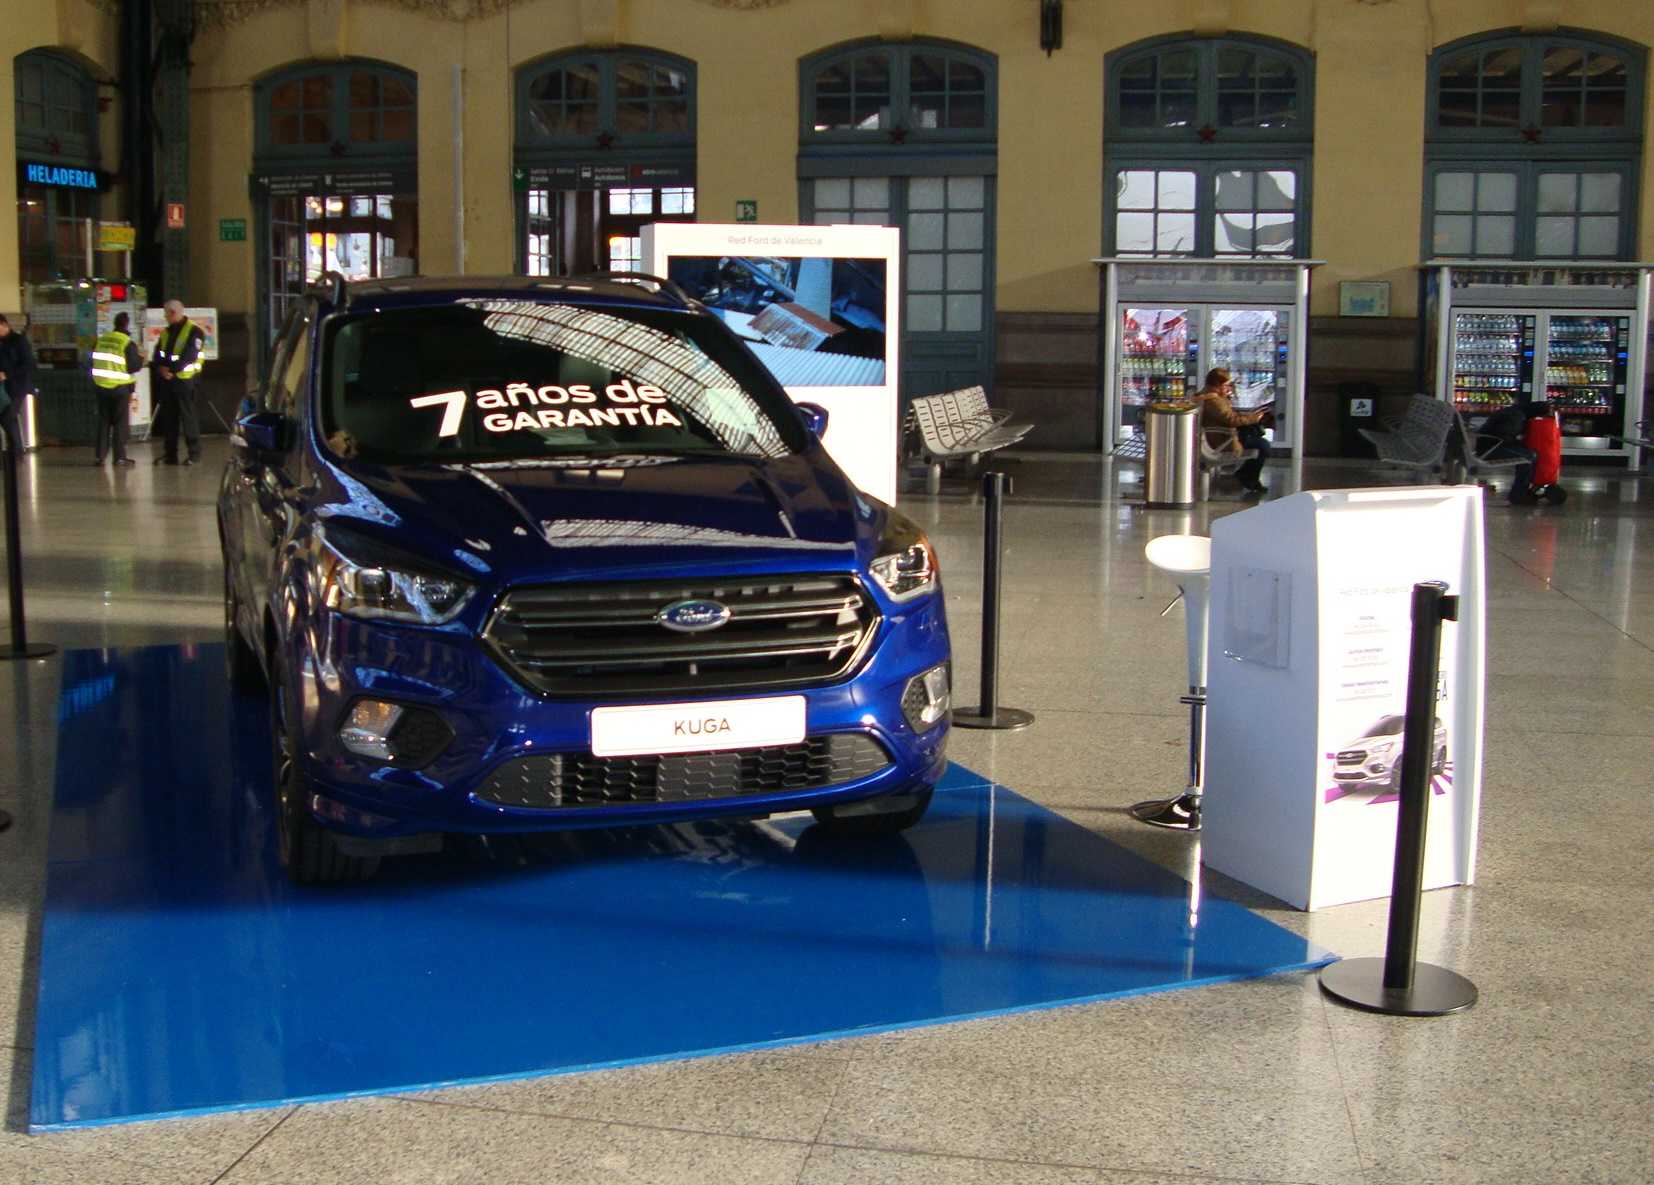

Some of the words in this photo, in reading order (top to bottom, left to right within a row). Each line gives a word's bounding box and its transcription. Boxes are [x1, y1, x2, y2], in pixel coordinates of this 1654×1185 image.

[27, 163, 97, 188] HELADERIA
[748, 235, 768, 245] Ford
[410, 390, 467, 437] 7
[475, 383, 597, 409] años
[605, 379, 667, 404] de
[482, 404, 682, 433] GARANTÍA
[673, 718, 731, 736] KUGA
